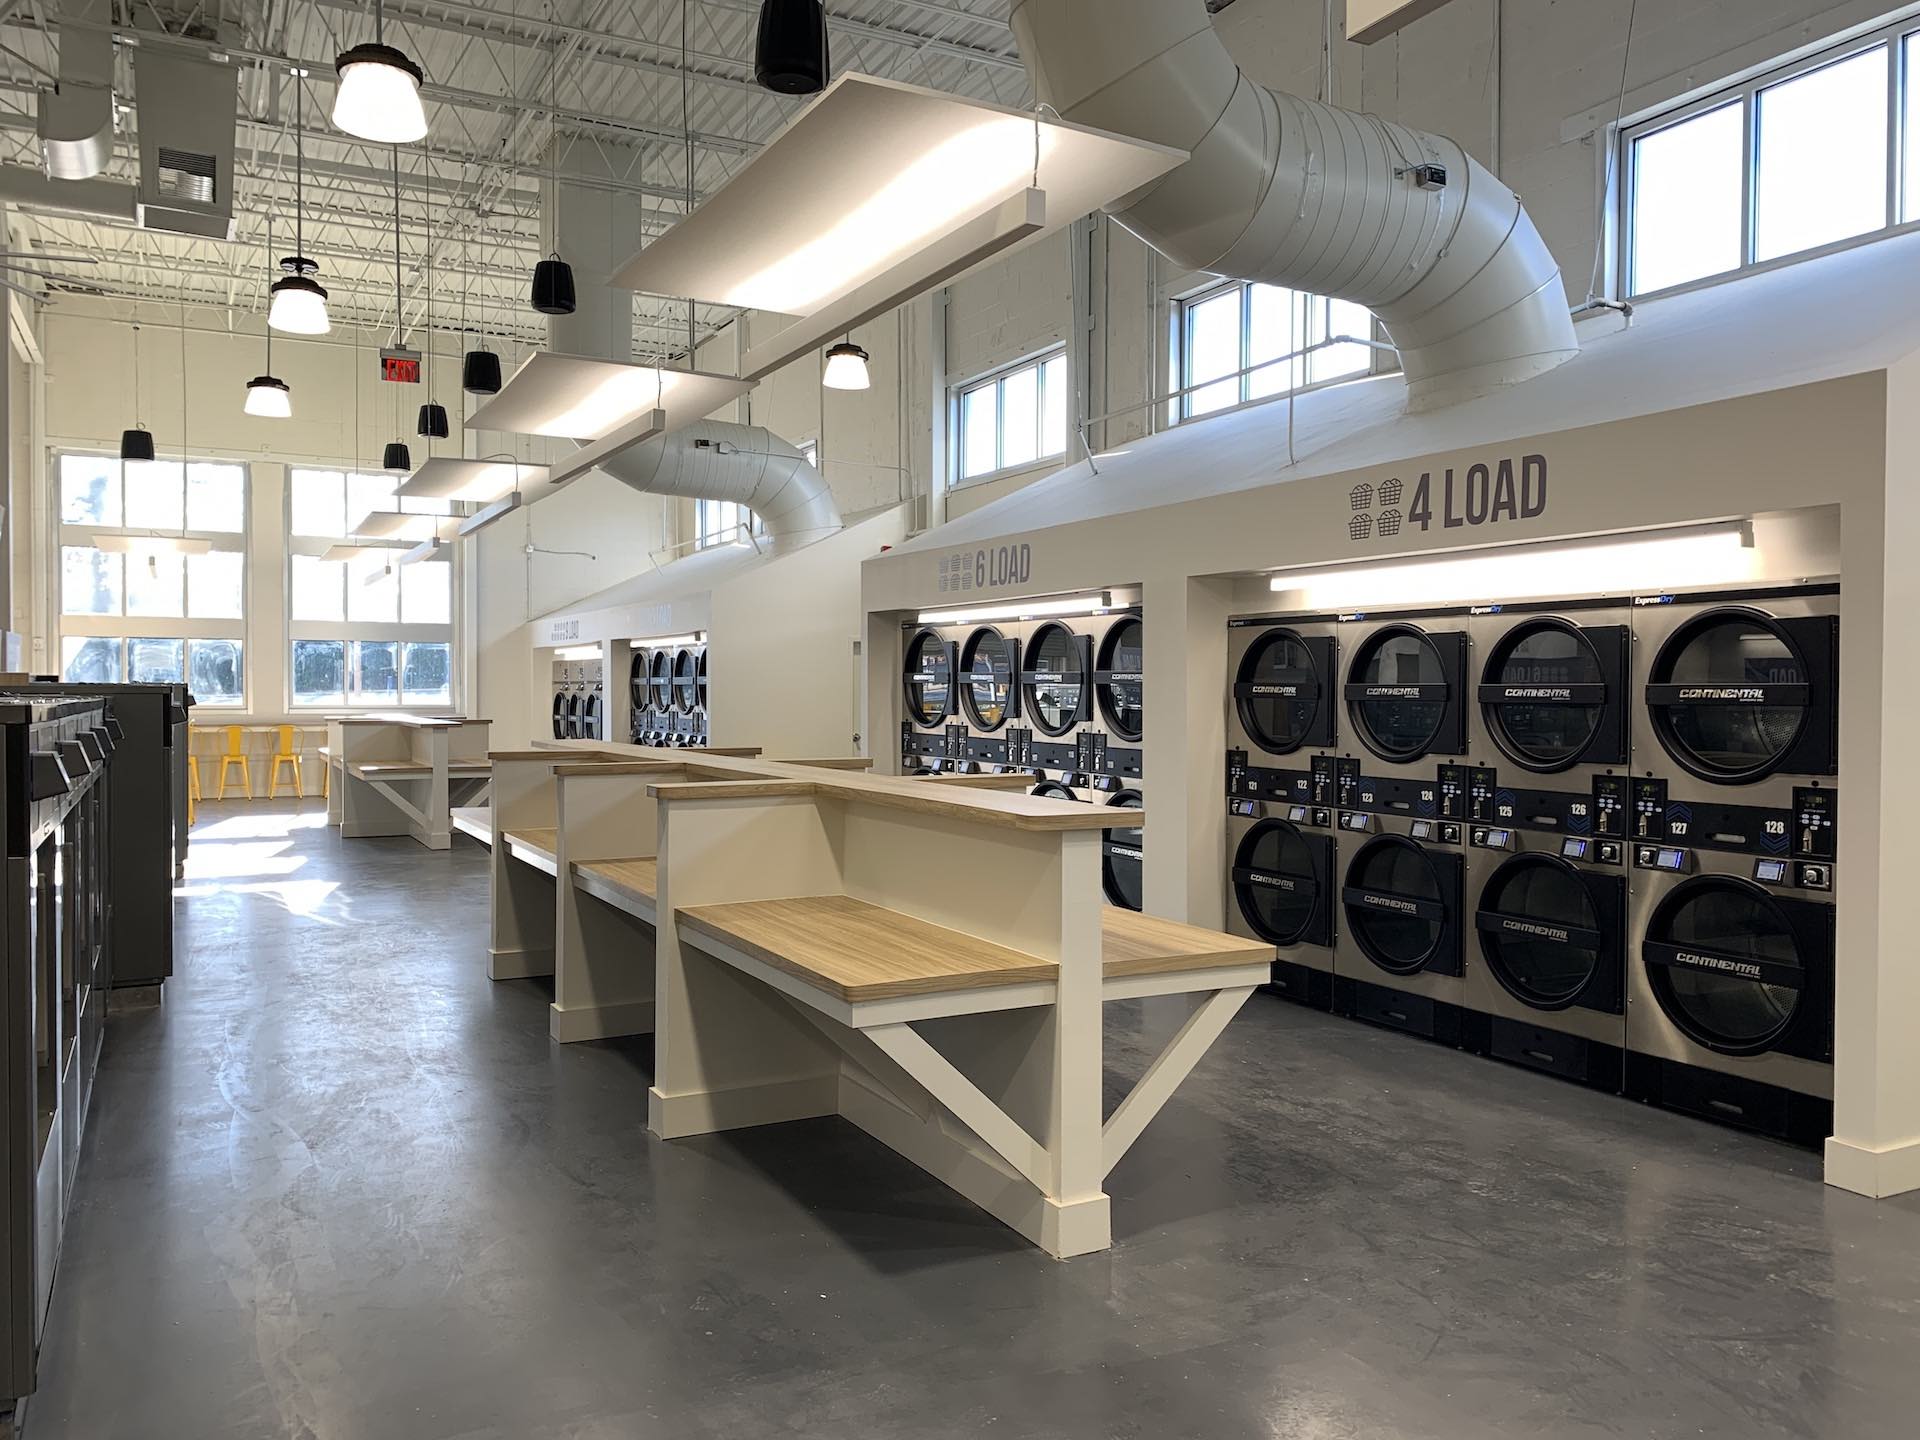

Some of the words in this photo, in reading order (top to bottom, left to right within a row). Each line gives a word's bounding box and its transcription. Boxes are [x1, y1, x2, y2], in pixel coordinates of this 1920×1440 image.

[386, 359, 416, 383] EXIT
[1408, 472, 1433, 531] 4
[1443, 454, 1547, 528] LOAD
[975, 550, 985, 588] 6
[989, 543, 1031, 586] LOAD
[1252, 686, 1297, 694] CONTINENTAL
[1366, 687, 1420, 696] CONTINENTAL
[1505, 688, 1571, 697] CONTINENTAL
[1679, 688, 1764, 699] CONTINENTAL
[1297, 780, 1308, 789] 122
[1361, 793, 1373, 803] 123
[1421, 791, 1433, 801] 124
[1498, 806, 1512, 817] 125
[1571, 804, 1586, 815] 126
[1671, 822, 1687, 834] 127
[1765, 820, 1784, 834] 128
[1250, 873, 1294, 889] CONTINENTAL
[1363, 894, 1417, 912] CONTINENTAL
[1502, 920, 1568, 940] CONTINENTAL
[1676, 952, 1761, 976] CONTINENTAL
